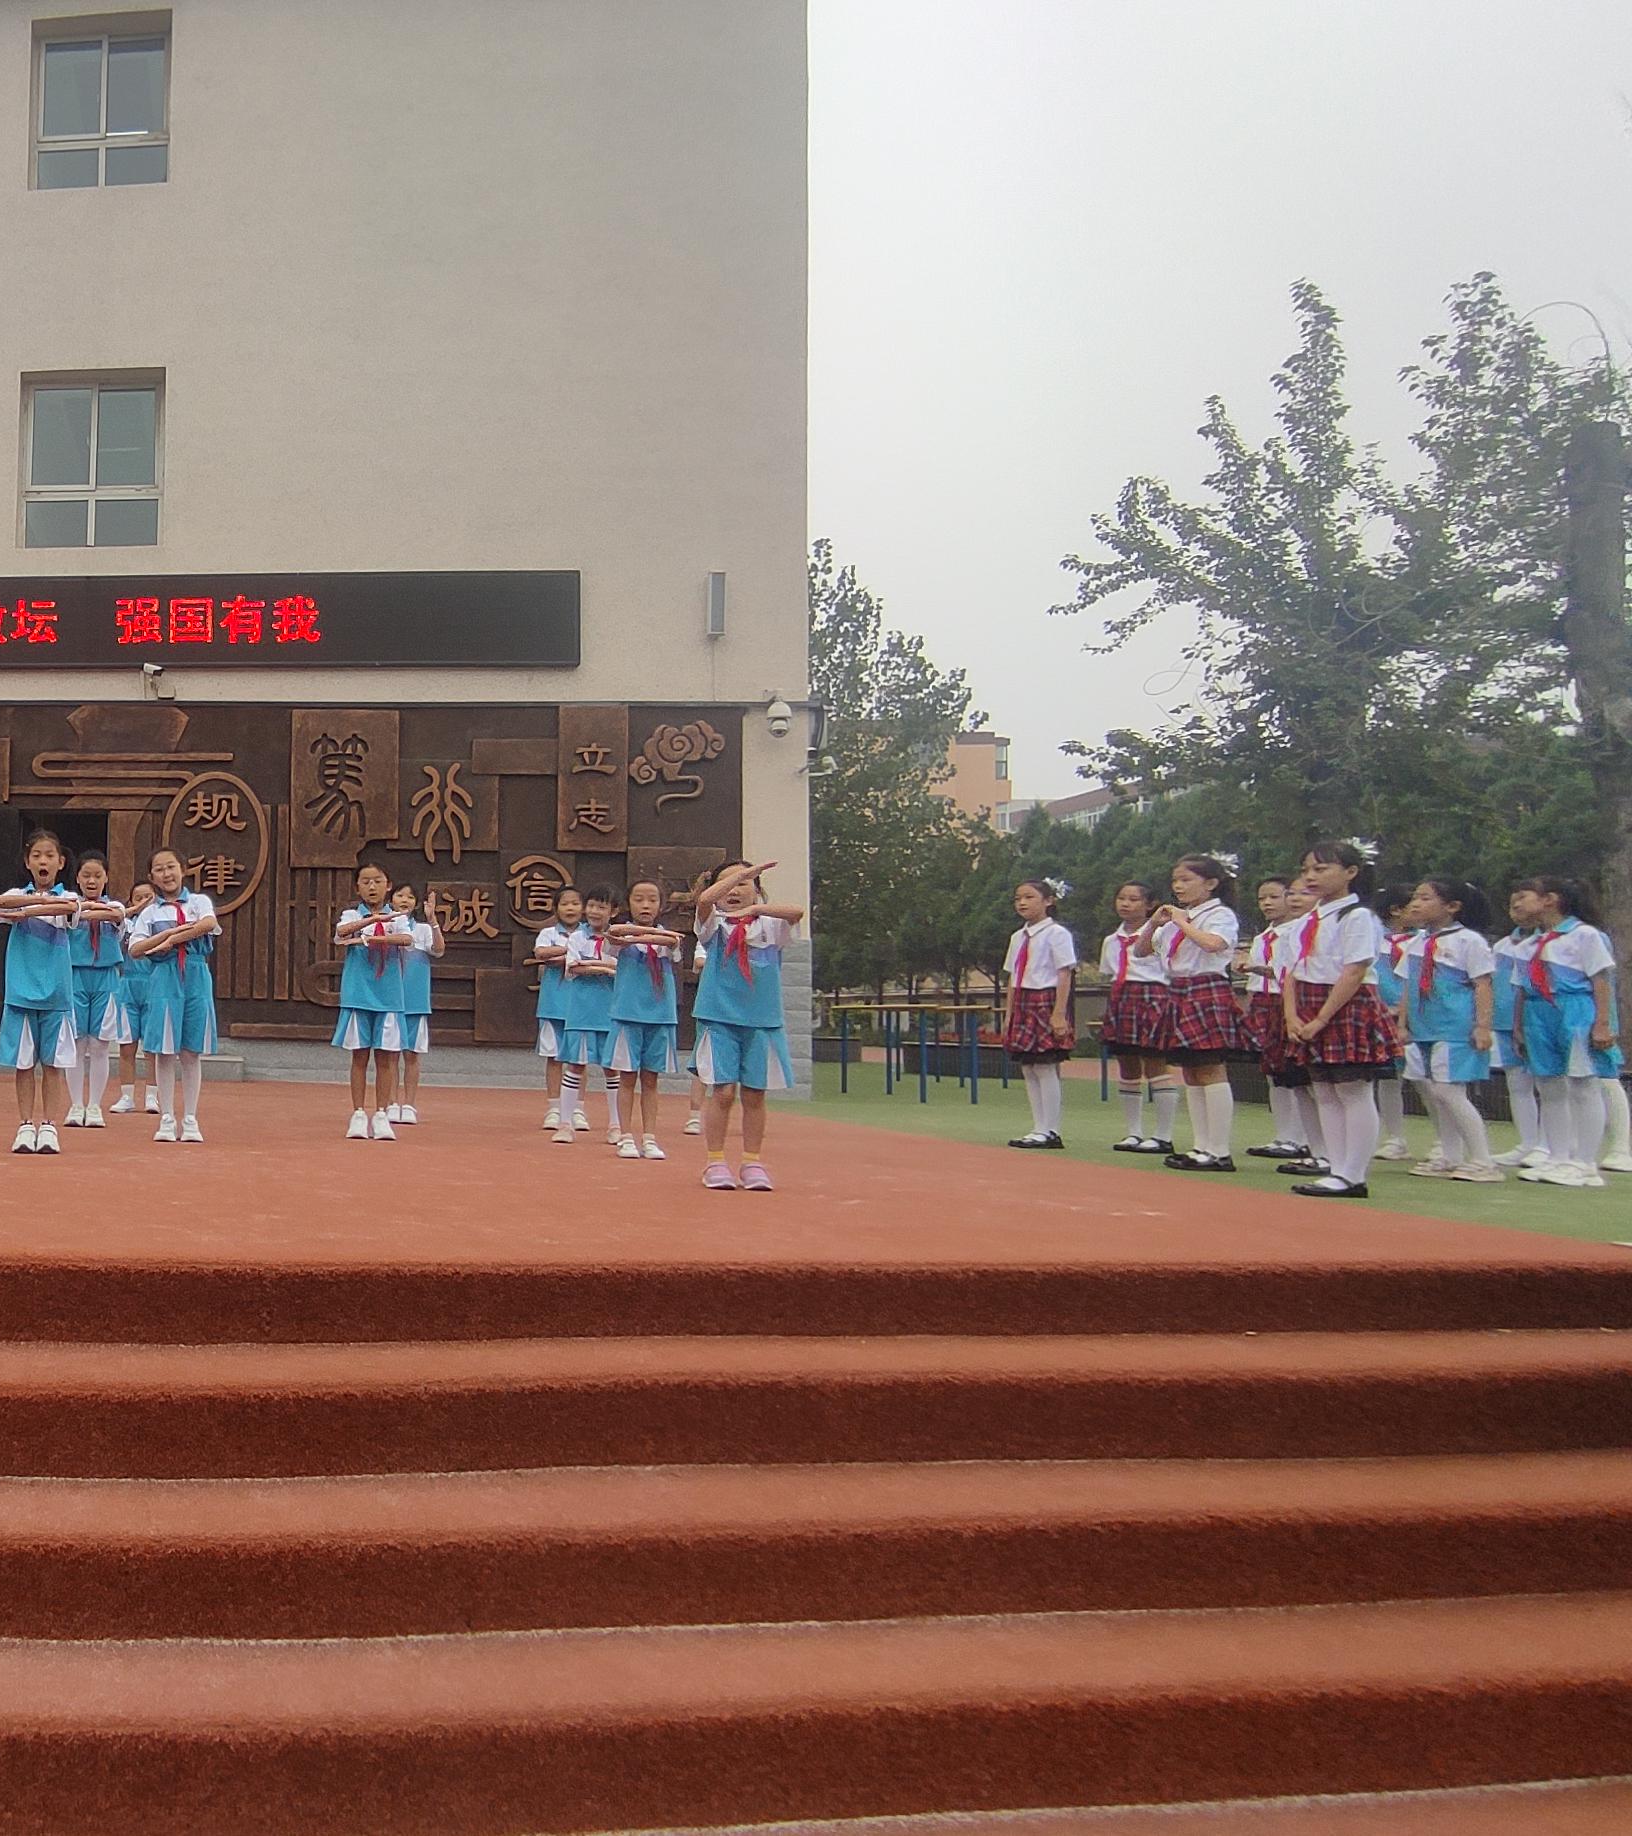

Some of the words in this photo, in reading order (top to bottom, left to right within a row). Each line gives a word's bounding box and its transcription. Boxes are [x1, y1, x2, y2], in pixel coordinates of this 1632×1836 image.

[114, 595, 322, 645] 强国有我
[568, 742, 617, 834] 立志
[183, 790, 248, 895] 规律
[505, 872, 562, 912] 信
